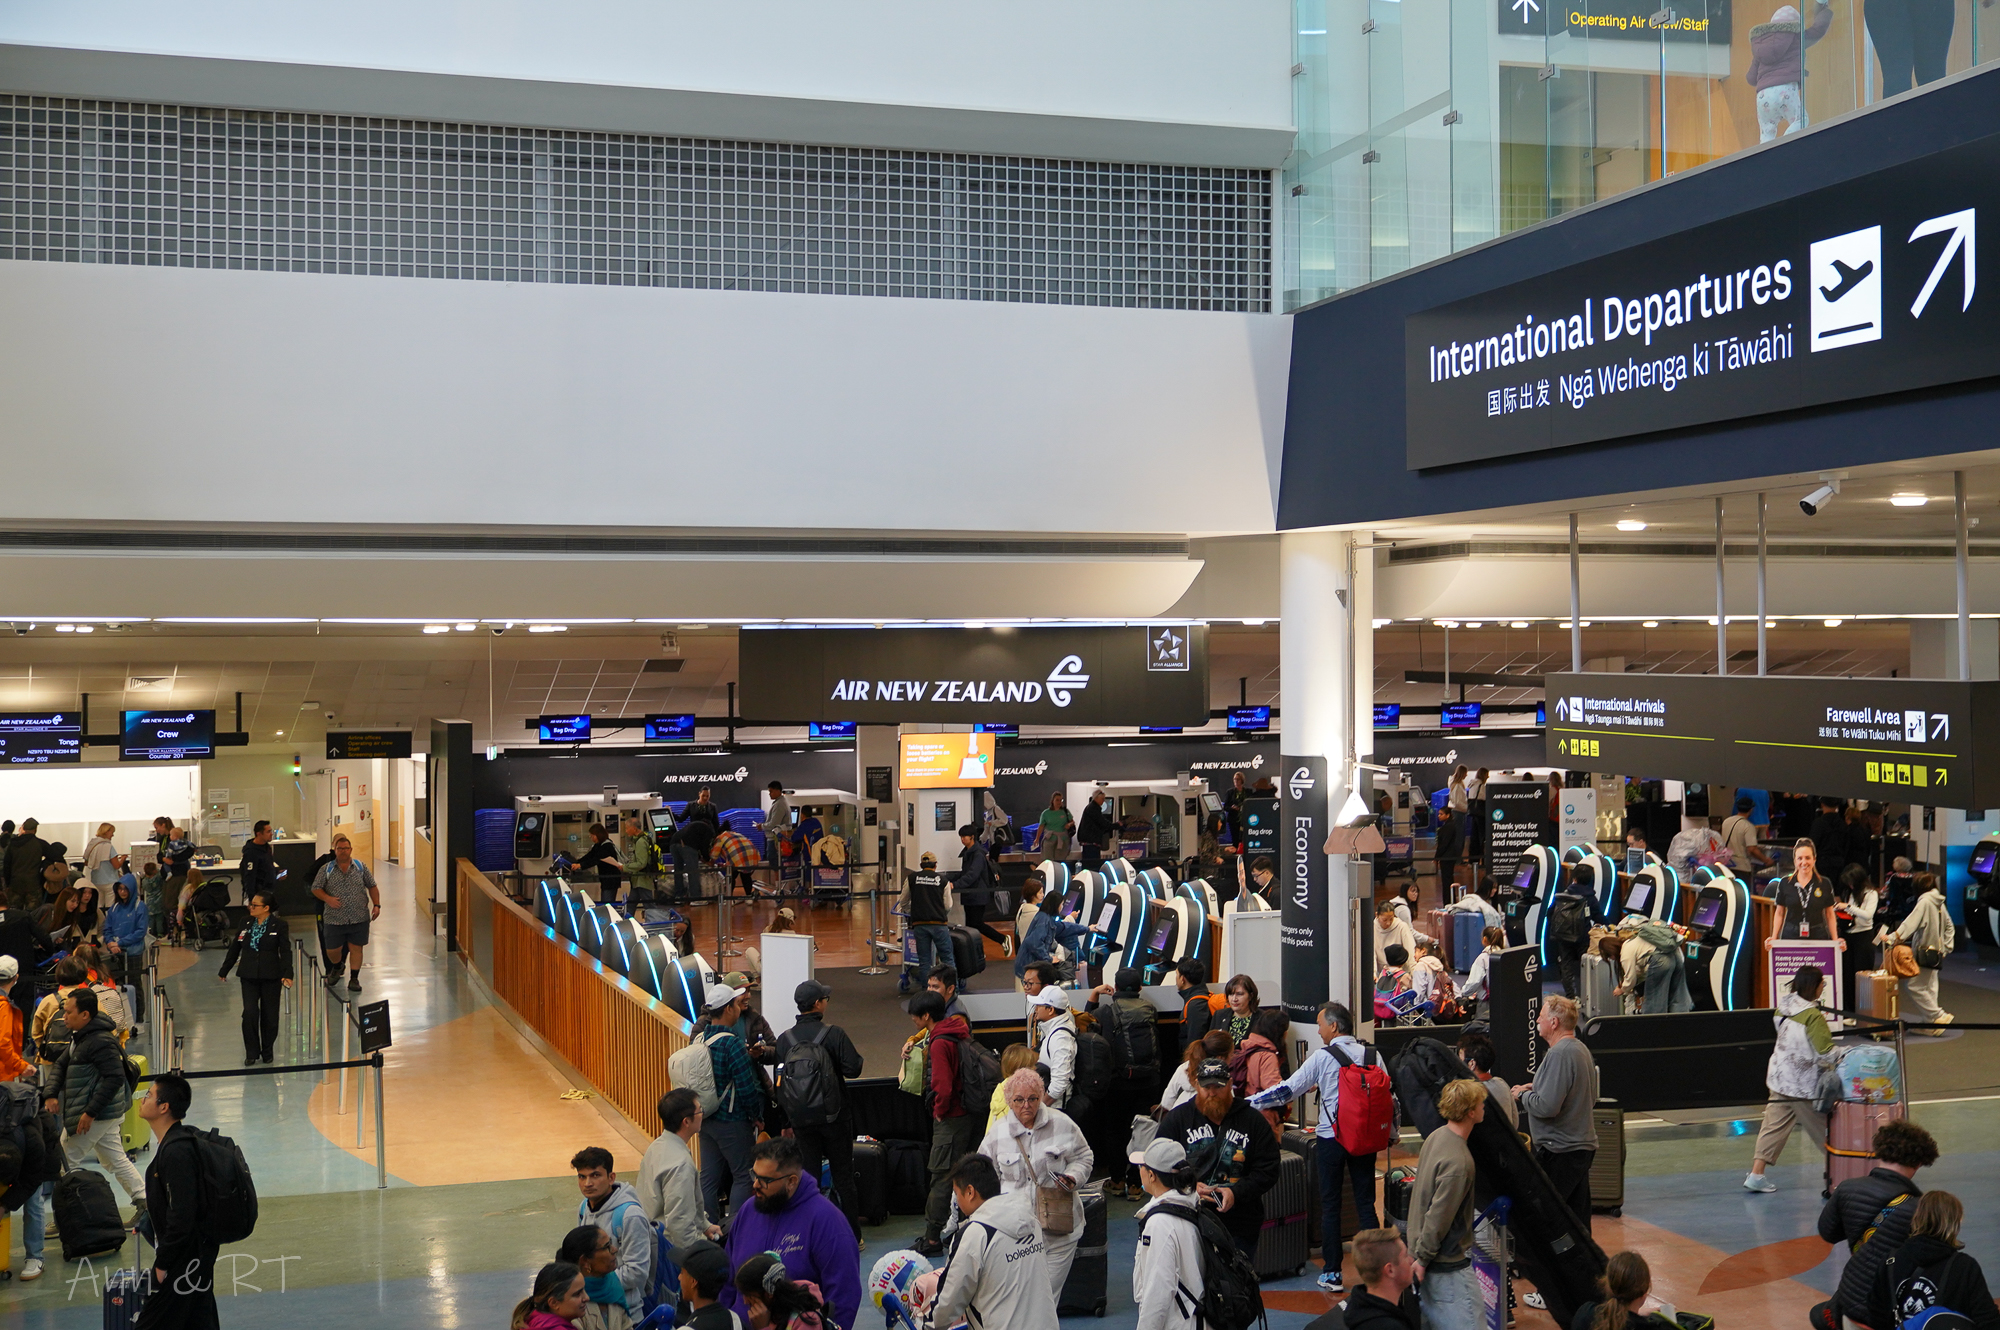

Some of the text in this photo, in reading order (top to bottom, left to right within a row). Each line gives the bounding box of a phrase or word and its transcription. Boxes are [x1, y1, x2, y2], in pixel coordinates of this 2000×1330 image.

[1570, 11, 1626, 31] Operating
[1630, 15, 1646, 29] Air
[1430, 259, 1792, 383] International Departures
[1560, 323, 1792, 410] Ngā Wehenga ki Tāwāhi
[1487, 378, 1551, 418] 国际出发
[831, 679, 1042, 703] AIR NEW ZEALAND
[1584, 698, 1665, 714] International Arrivals
[1826, 707, 1900, 725] Farewell Area
[157, 730, 179, 738] Crew
[1842, 727, 1902, 742] Te Wāhi Tuku Mihi
[247, 862, 254, 871] 3
[1293, 816, 1312, 910] Economy
[1299, 927, 1313, 937] only
[1296, 939, 1313, 947] point
[1287, 1002, 1308, 1011] ALLIANCE
[1526, 997, 1538, 1074] Economy
[879, 1258, 905, 1289] HOME
